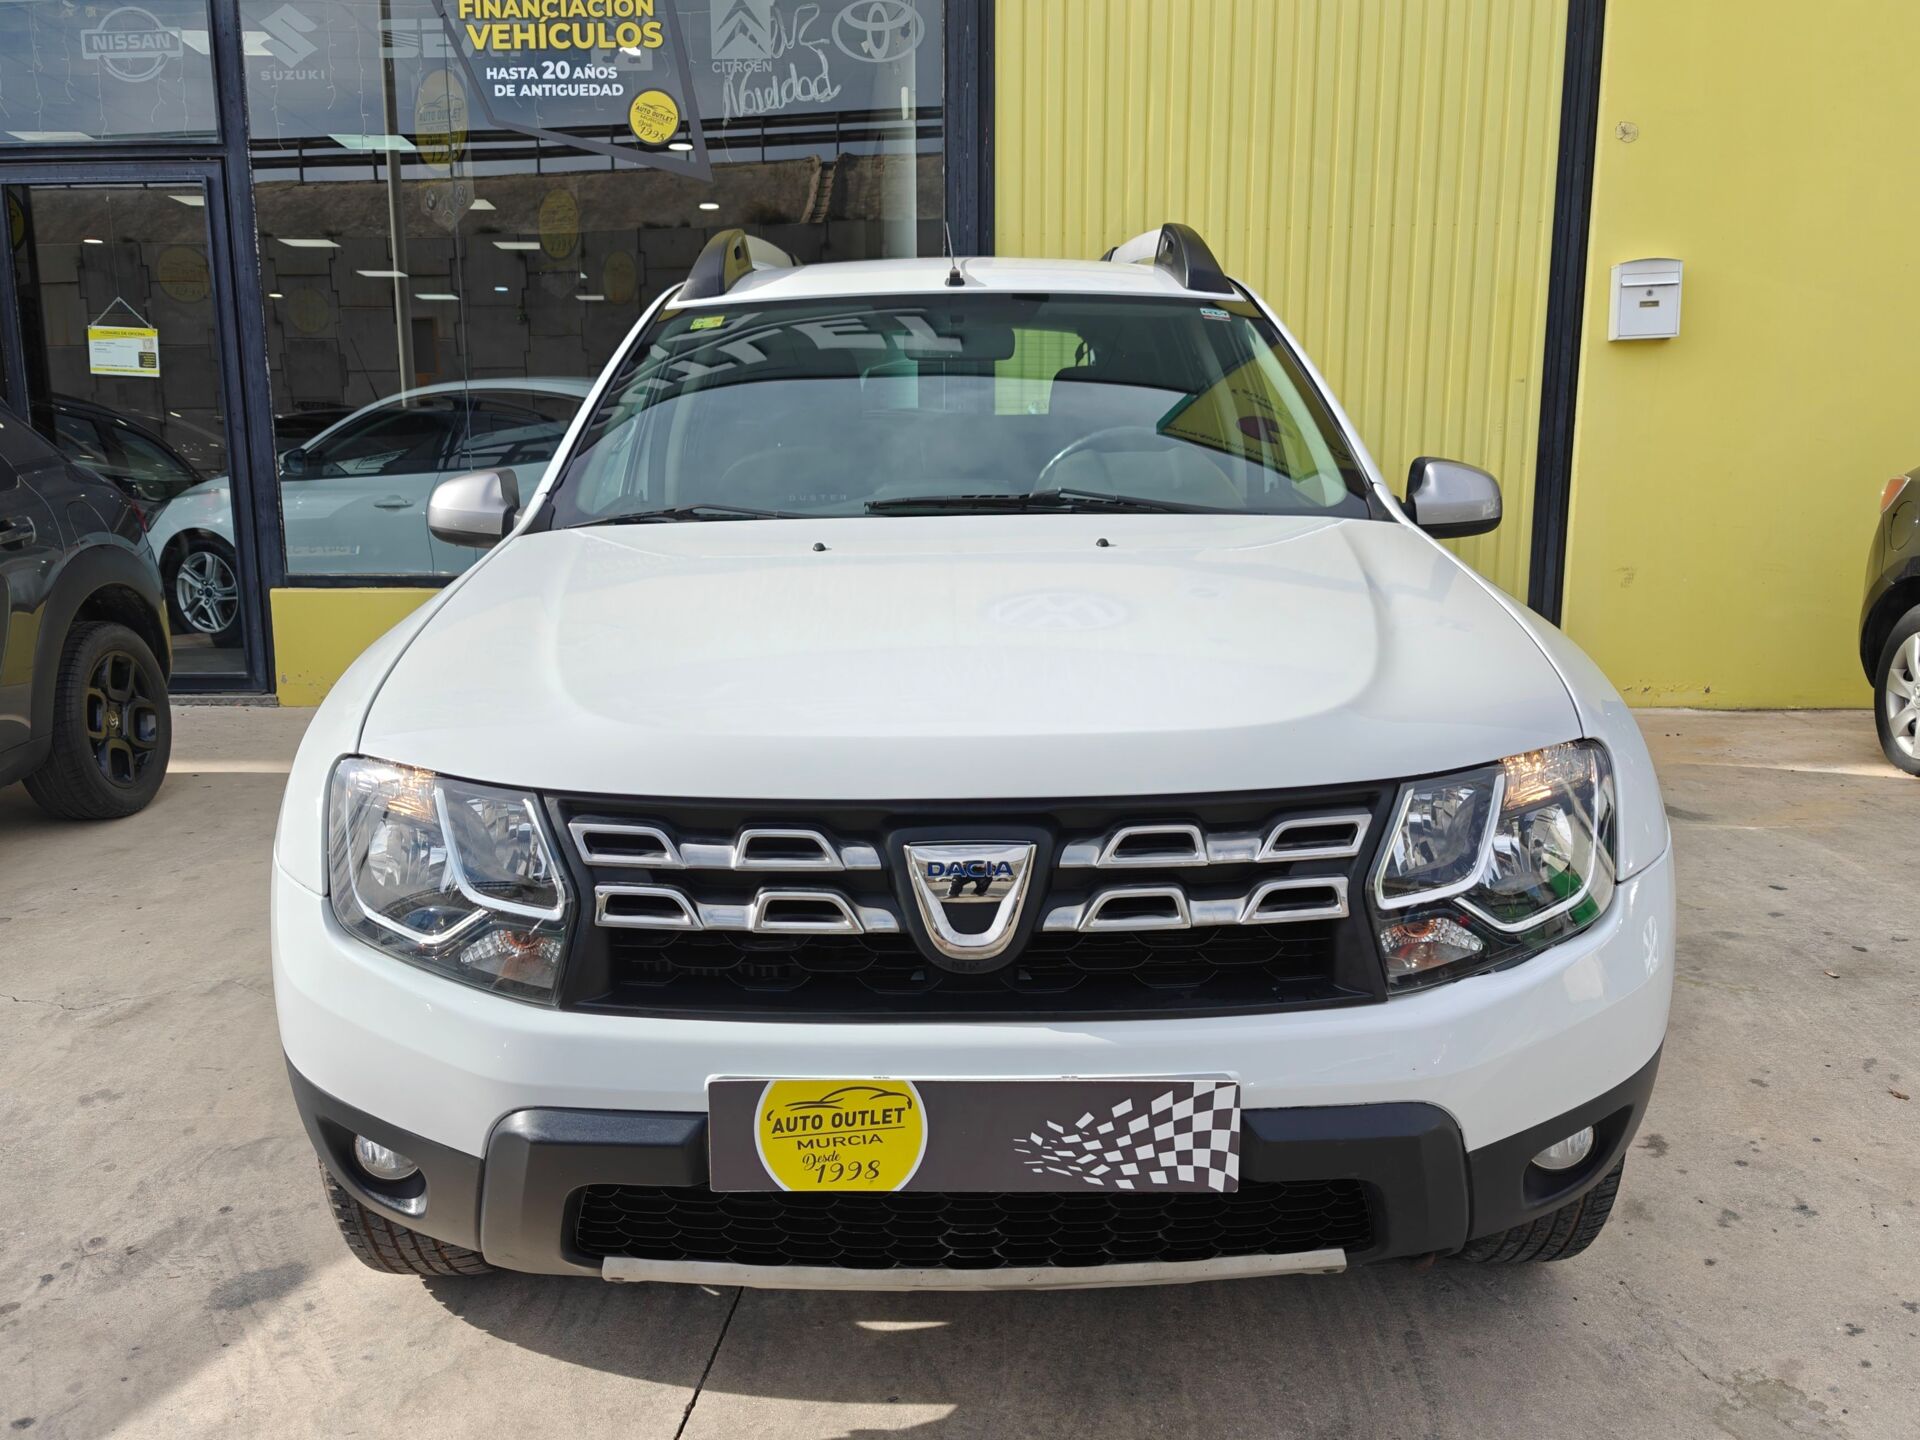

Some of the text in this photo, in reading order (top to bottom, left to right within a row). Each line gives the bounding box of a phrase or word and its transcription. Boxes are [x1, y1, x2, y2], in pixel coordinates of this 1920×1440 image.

[92, 33, 171, 50] NISSAN
[466, 16, 664, 50] VEHÍCULOS
[260, 70, 325, 81] SUZUKI
[486, 61, 618, 80] HASTA 20 AÑOS
[494, 84, 624, 97] DE ANTIGUEDAD
[636, 105, 673, 123] AUTO OUTLET
[927, 860, 1014, 878] DACIA
[771, 1107, 906, 1134] AUTO OUTLET
[797, 1133, 884, 1150] MURCIA
[802, 1150, 841, 1171] Desde
[815, 1159, 881, 1184] 1998
